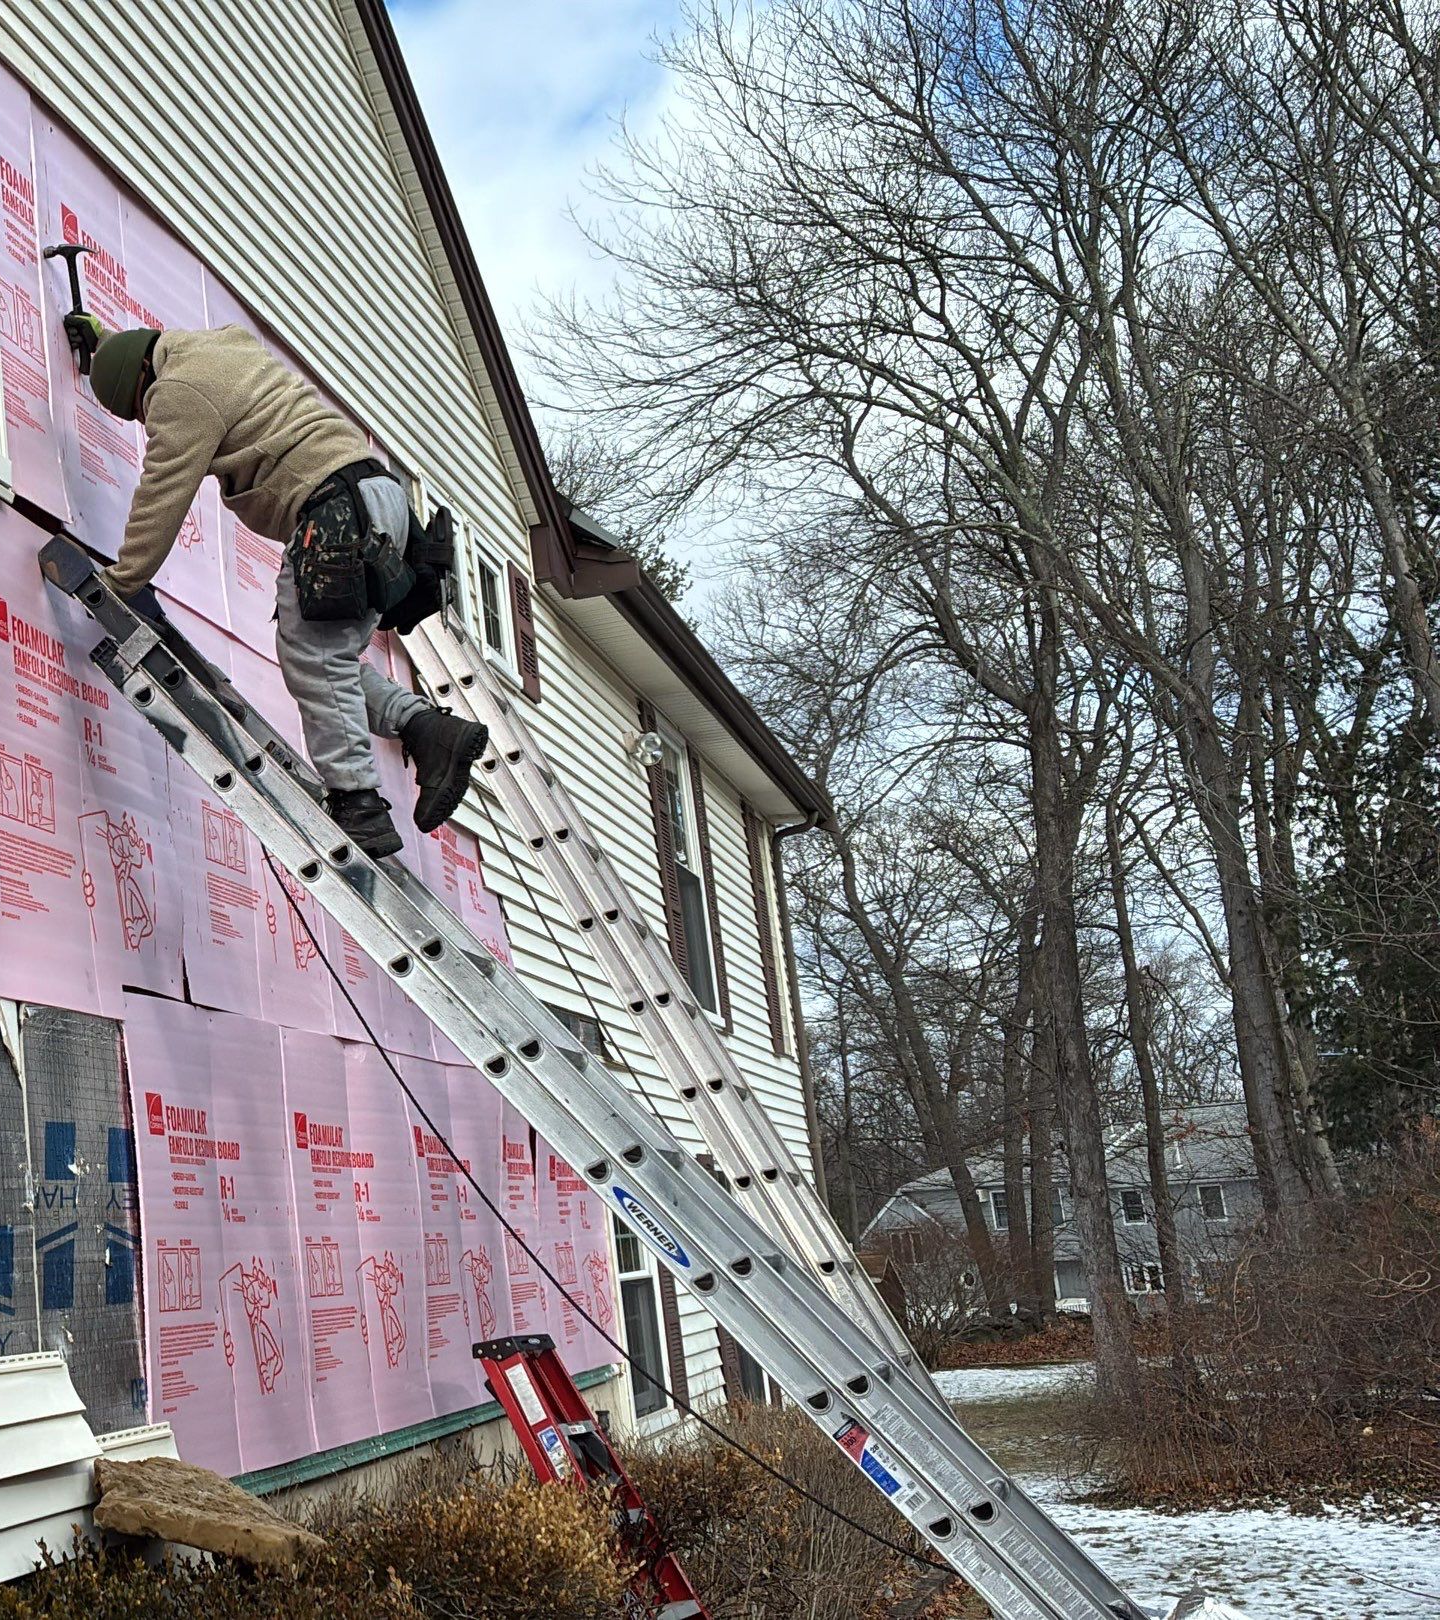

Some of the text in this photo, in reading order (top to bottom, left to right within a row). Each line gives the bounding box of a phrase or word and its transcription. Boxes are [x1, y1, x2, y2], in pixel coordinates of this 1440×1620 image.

[11, 615, 65, 668] FOAMULAR
[13, 645, 46, 679] FANFOLD
[48, 664, 79, 698] RESIDING
[81, 682, 109, 710] BOARD
[84, 717, 103, 747] R-1
[165, 1105, 207, 1135] FOAMULAR
[218, 1141, 240, 1160] BOARD
[352, 1152, 374, 1168] BOARD
[220, 1176, 235, 1200] R-1
[354, 1182, 369, 1202] R-1
[627, 1201, 677, 1252] WERNER
